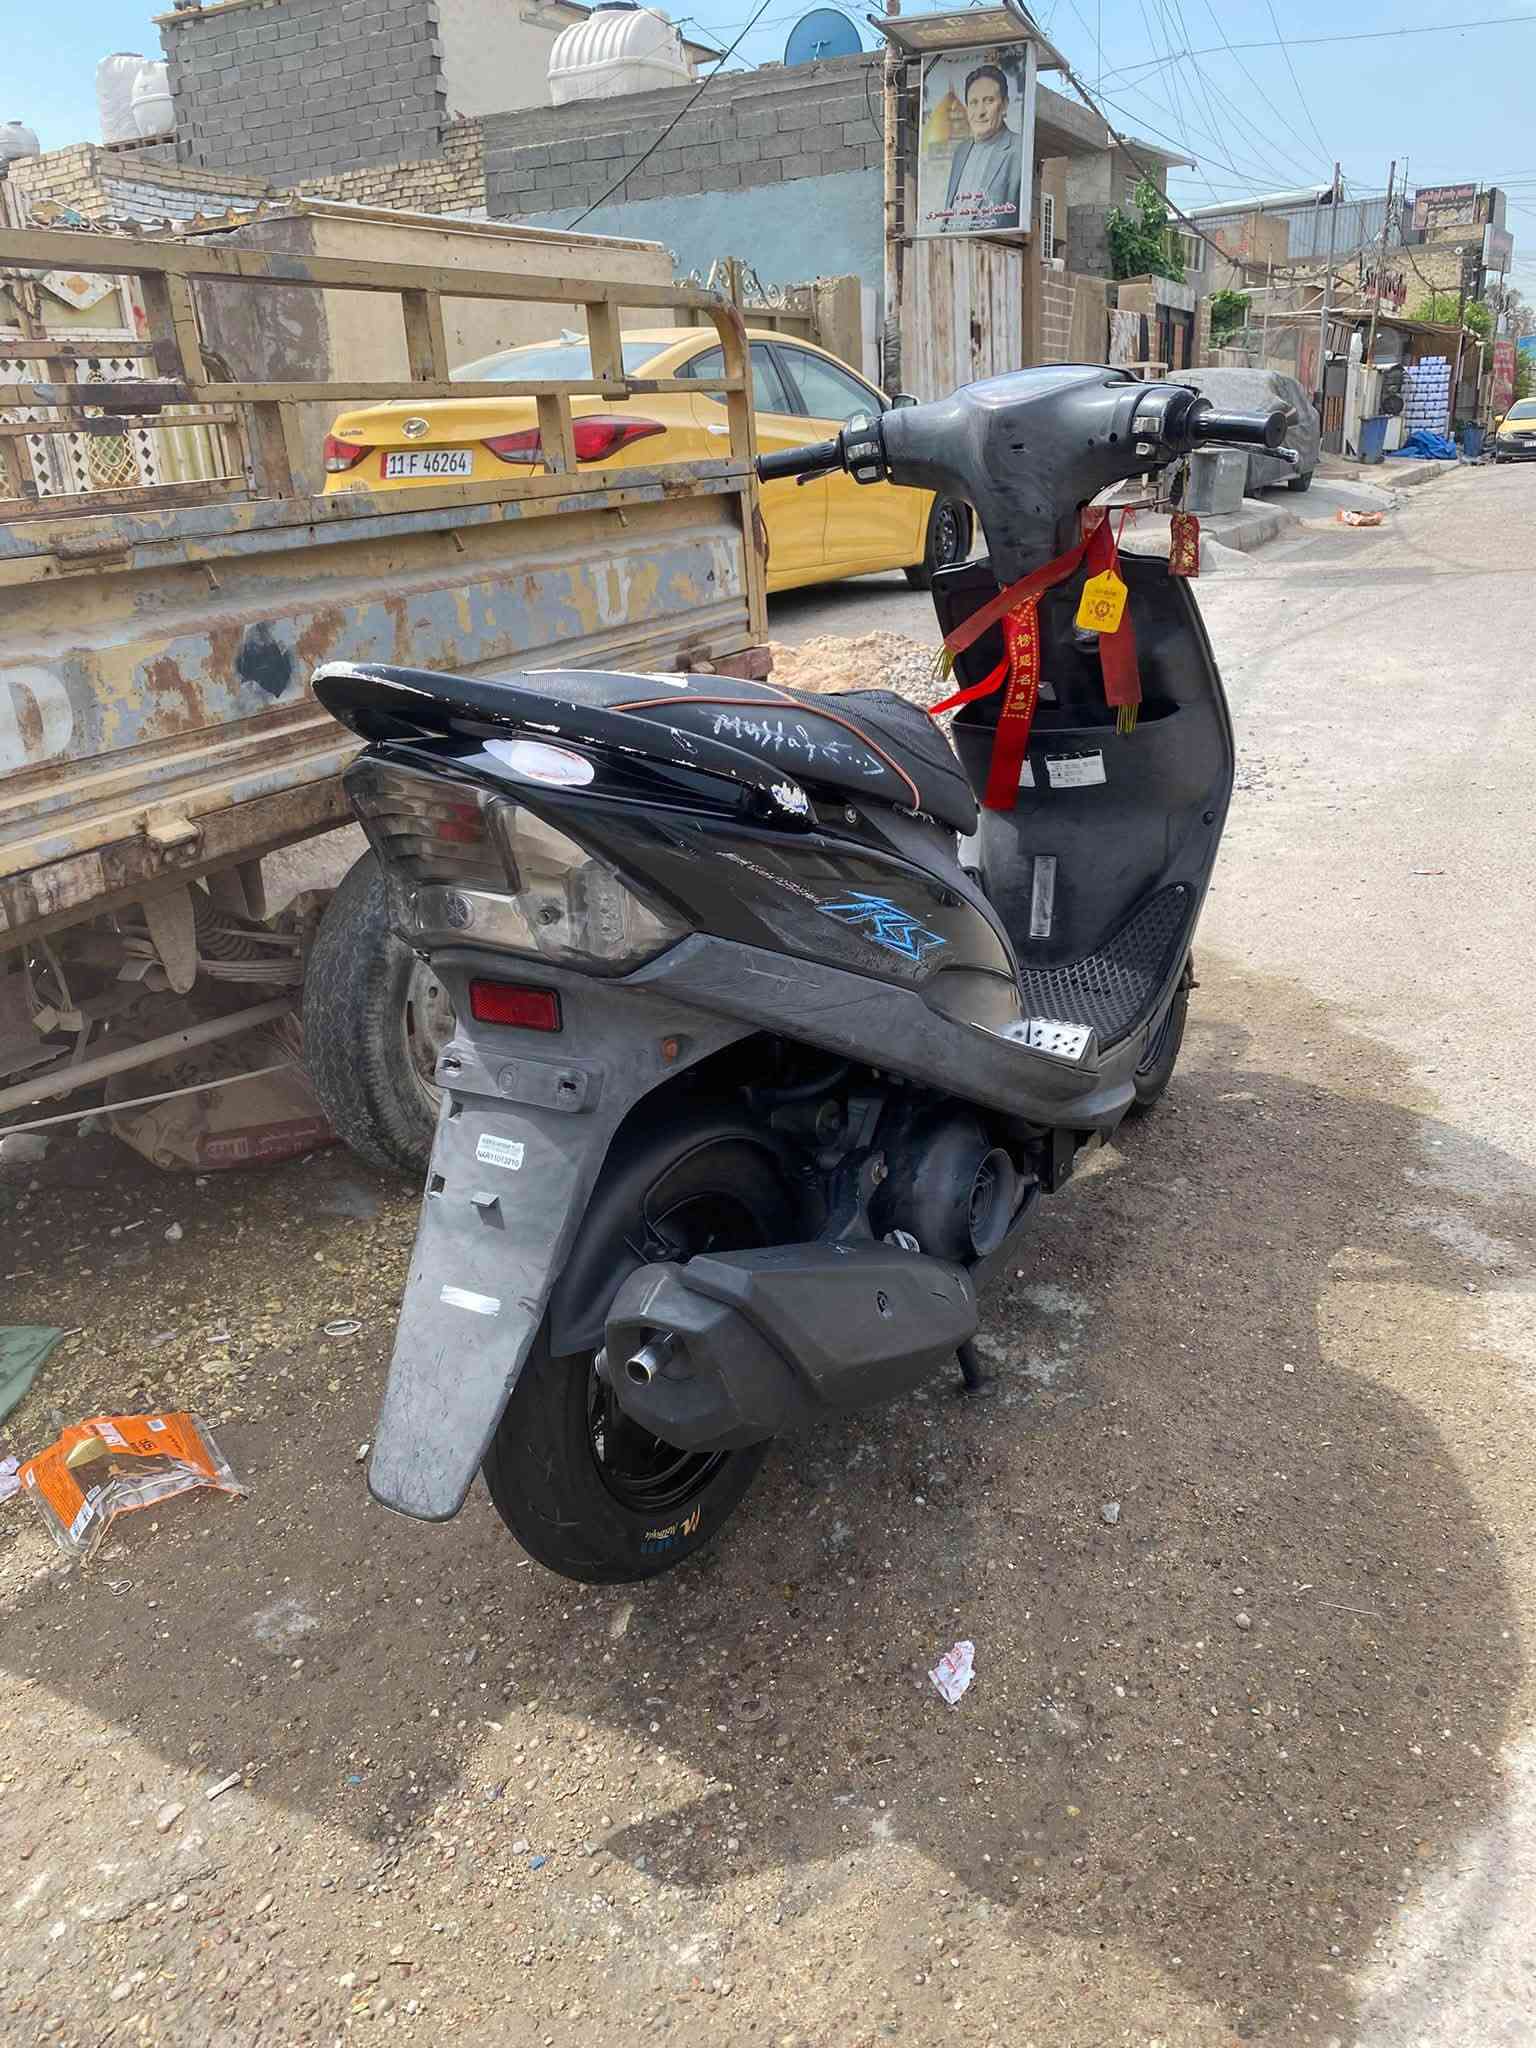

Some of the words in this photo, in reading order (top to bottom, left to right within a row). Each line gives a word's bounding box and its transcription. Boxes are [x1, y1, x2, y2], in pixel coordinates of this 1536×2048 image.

[389, 456, 404, 474] 11
[410, 454, 418, 473] F
[423, 453, 466, 473] 46264
